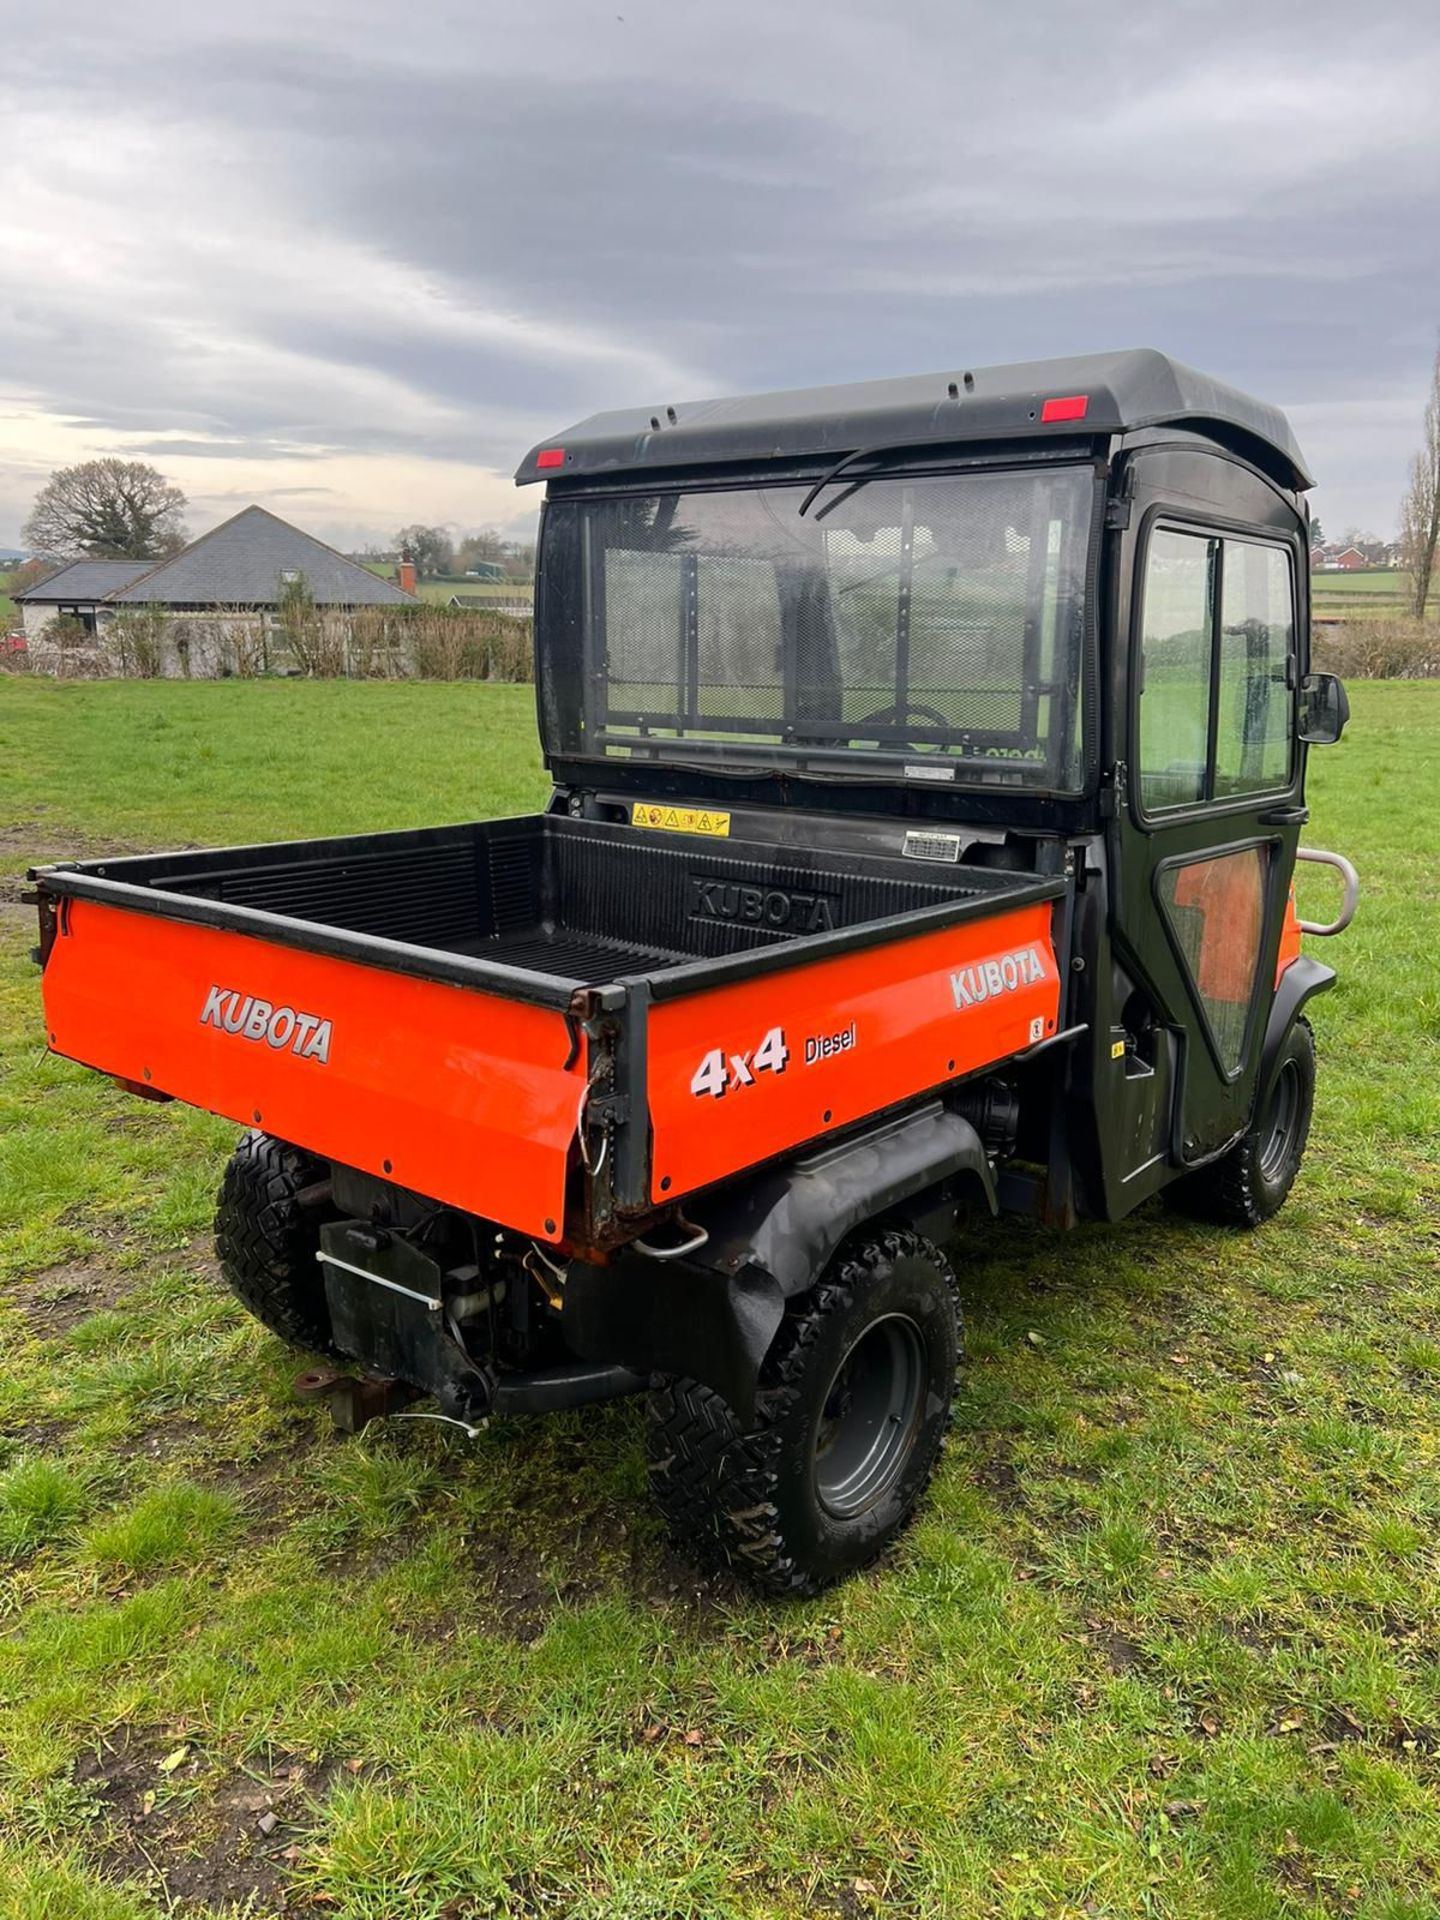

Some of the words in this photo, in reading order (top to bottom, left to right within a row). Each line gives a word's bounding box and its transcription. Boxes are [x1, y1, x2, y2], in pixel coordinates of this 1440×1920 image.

[691, 879, 834, 931] KUBOTA
[950, 948, 1045, 1009] KUBOTA
[200, 984, 332, 1064] KUBOTA
[690, 1026, 790, 1099] 4x4
[804, 1020, 857, 1066] Diesel
